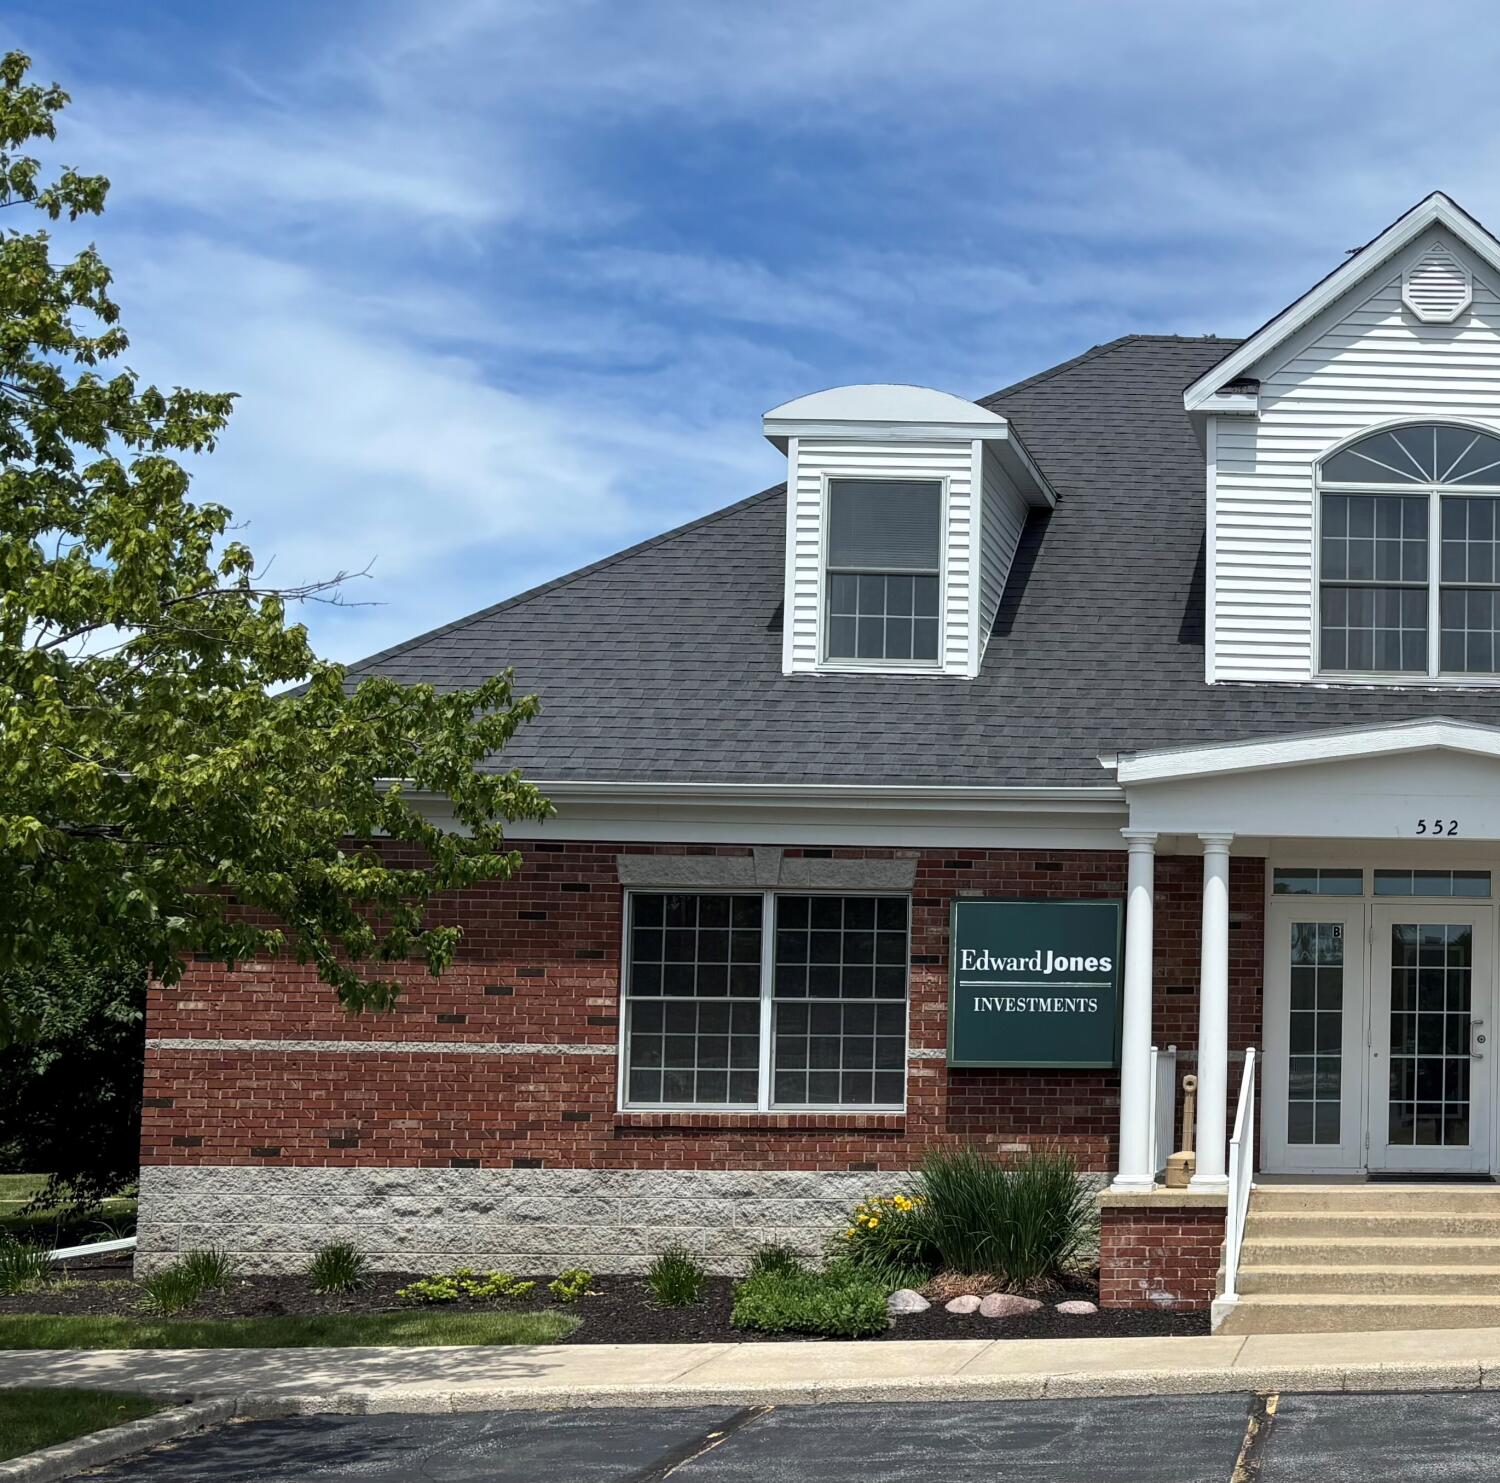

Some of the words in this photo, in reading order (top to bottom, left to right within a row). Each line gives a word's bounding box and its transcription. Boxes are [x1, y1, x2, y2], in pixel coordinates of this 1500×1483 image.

[1415, 819, 1459, 836] 552
[1333, 926, 1341, 937] B
[959, 949, 1042, 972] Edward
[1043, 950, 1112, 975] Jones
[973, 997, 1098, 1013] INVESTMENTS
